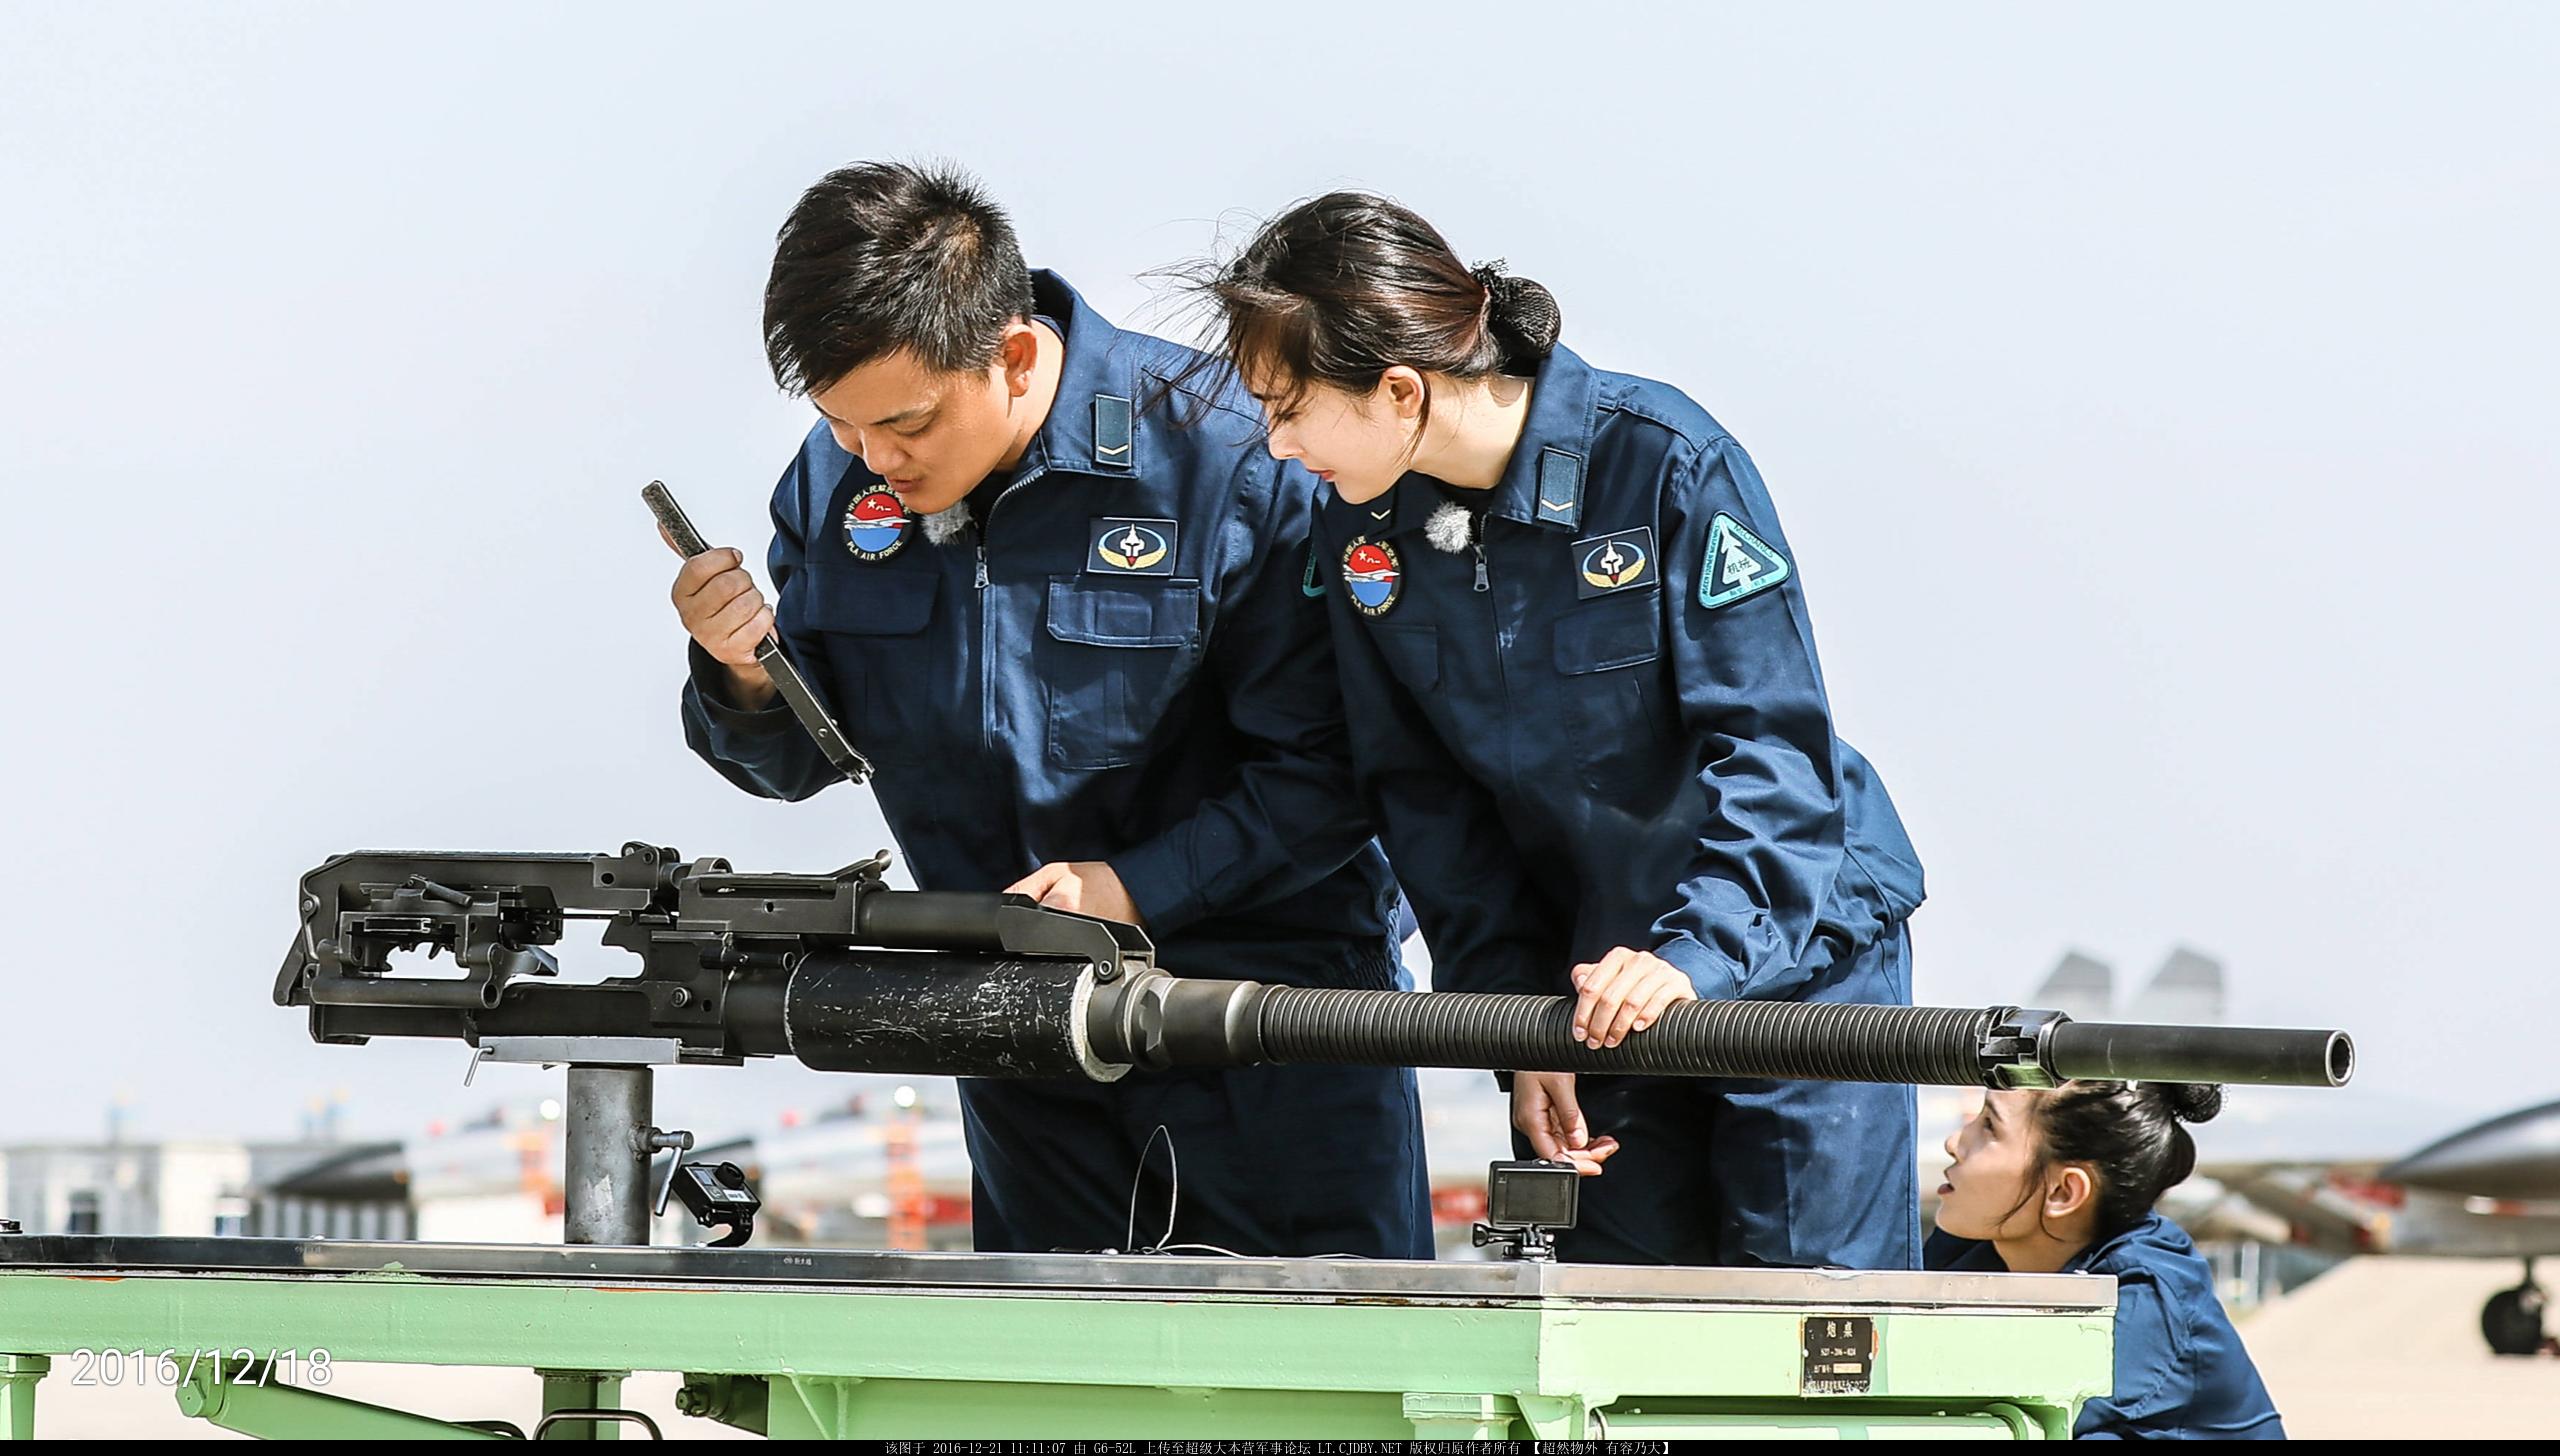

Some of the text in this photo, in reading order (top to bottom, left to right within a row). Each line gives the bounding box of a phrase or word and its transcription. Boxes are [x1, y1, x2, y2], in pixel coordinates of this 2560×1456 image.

[847, 539, 904, 560] PLA AIR FORCE
[1727, 557, 1752, 575] 机械
